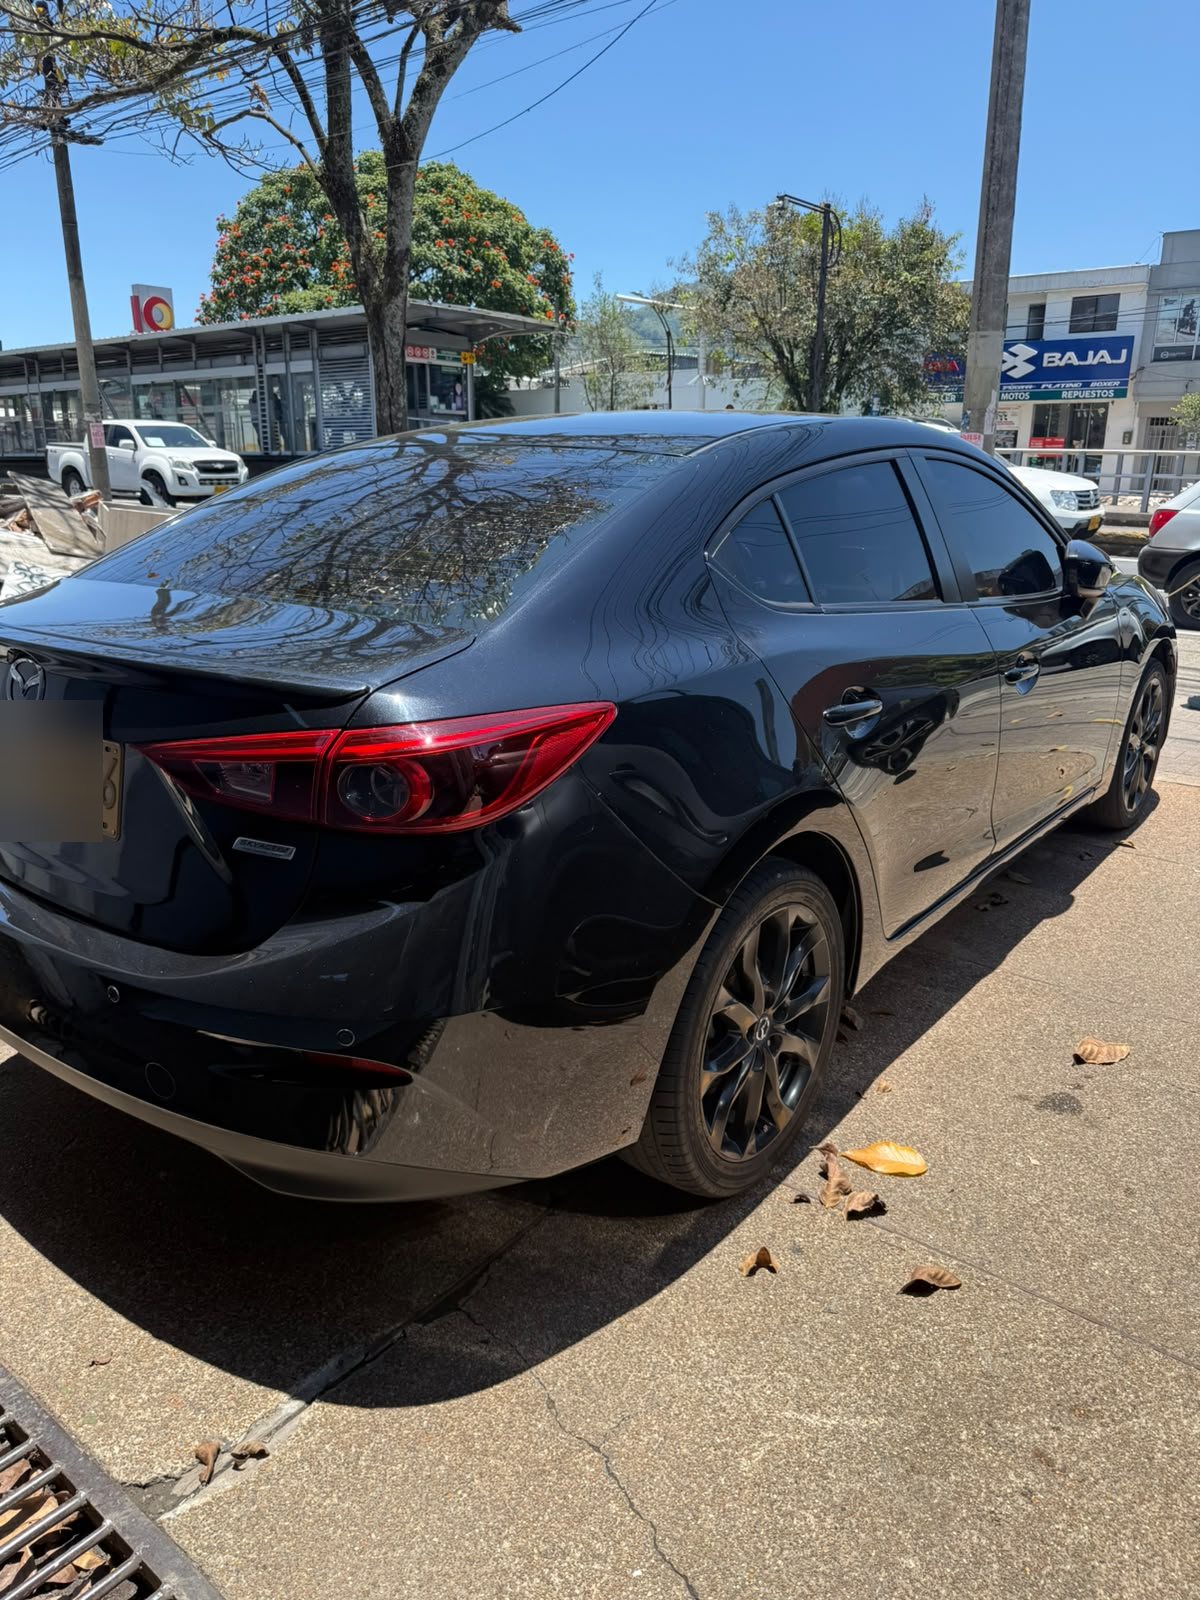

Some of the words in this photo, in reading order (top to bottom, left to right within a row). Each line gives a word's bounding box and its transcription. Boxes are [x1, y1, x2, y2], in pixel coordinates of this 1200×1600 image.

[1042, 349, 1128, 368] BAJAJ
[1000, 392, 1031, 400] MOTOS
[1062, 390, 1115, 399] REPUESTOS
